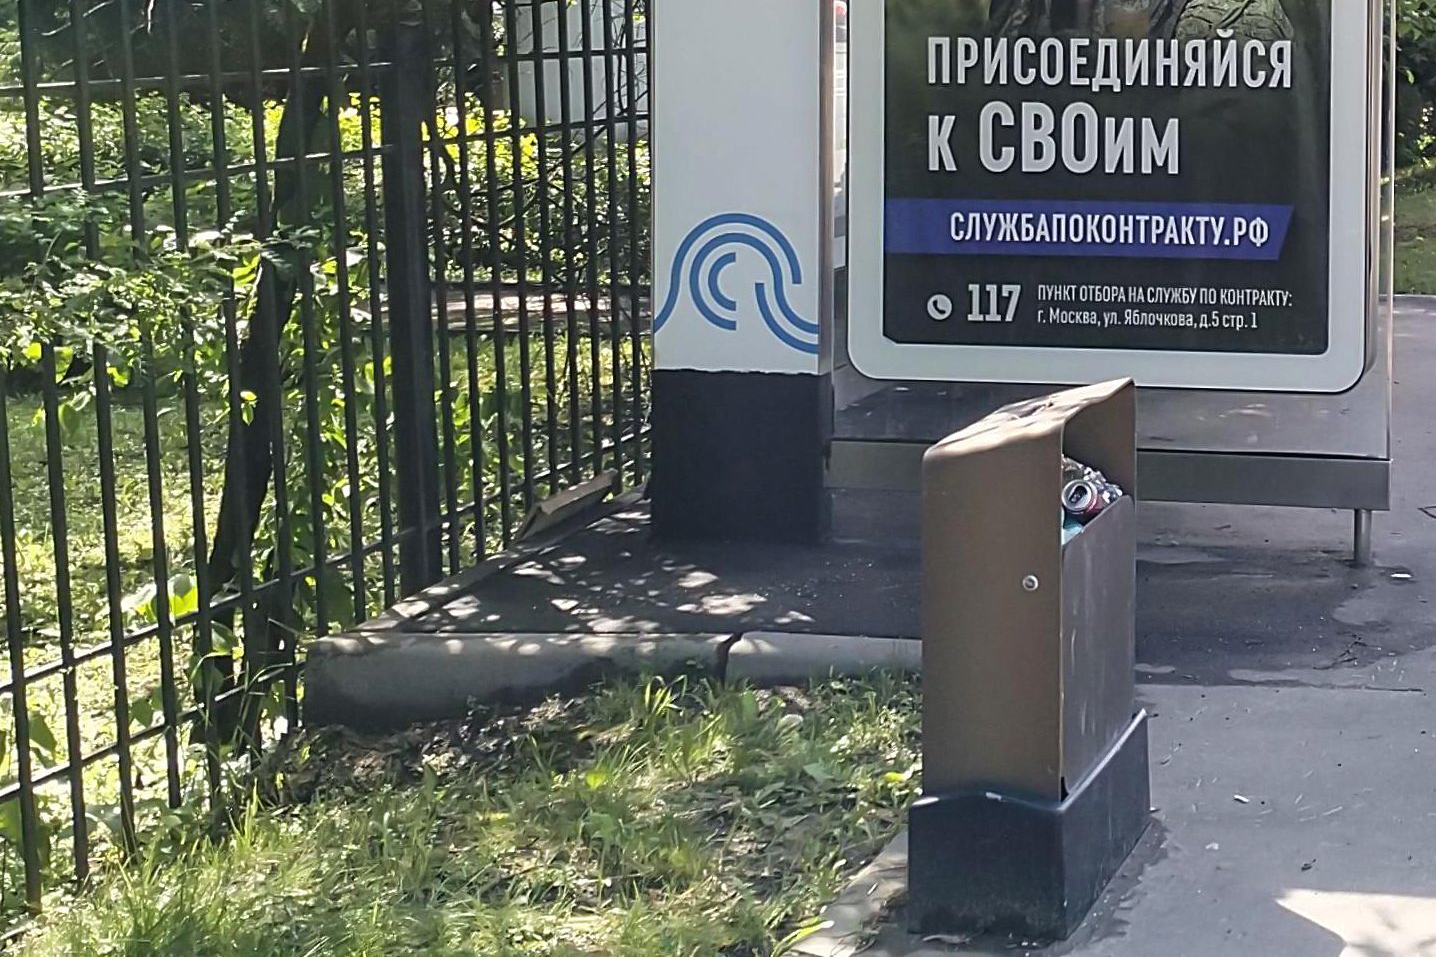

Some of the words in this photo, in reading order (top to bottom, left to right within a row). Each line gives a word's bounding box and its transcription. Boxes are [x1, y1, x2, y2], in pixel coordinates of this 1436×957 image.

[927, 28, 1292, 92] ПРИСОЕДИНЯЙСЯ
[949, 211, 1270, 248] СЛУЖБАПОКОНТРАКТУ.РФ
[966, 283, 1022, 323] 117
[1037, 284, 1077, 302] ПУНКТ
[1079, 285, 1126, 303] ОТБОРА
[1128, 286, 1145, 304] НА
[1147, 287, 1198, 305] СЛУЖБУ
[1199, 288, 1217, 305] ПО
[1220, 288, 1293, 307] КОНТРАКТУ:
[1037, 310, 1047, 324] г.
[1049, 307, 1101, 327] Москва,
[1103, 311, 1122, 328] ул.
[1124, 309, 1197, 329] Яблочкова,
[1222, 312, 1248, 331] стр.
[1250, 312, 1258, 329] 1
